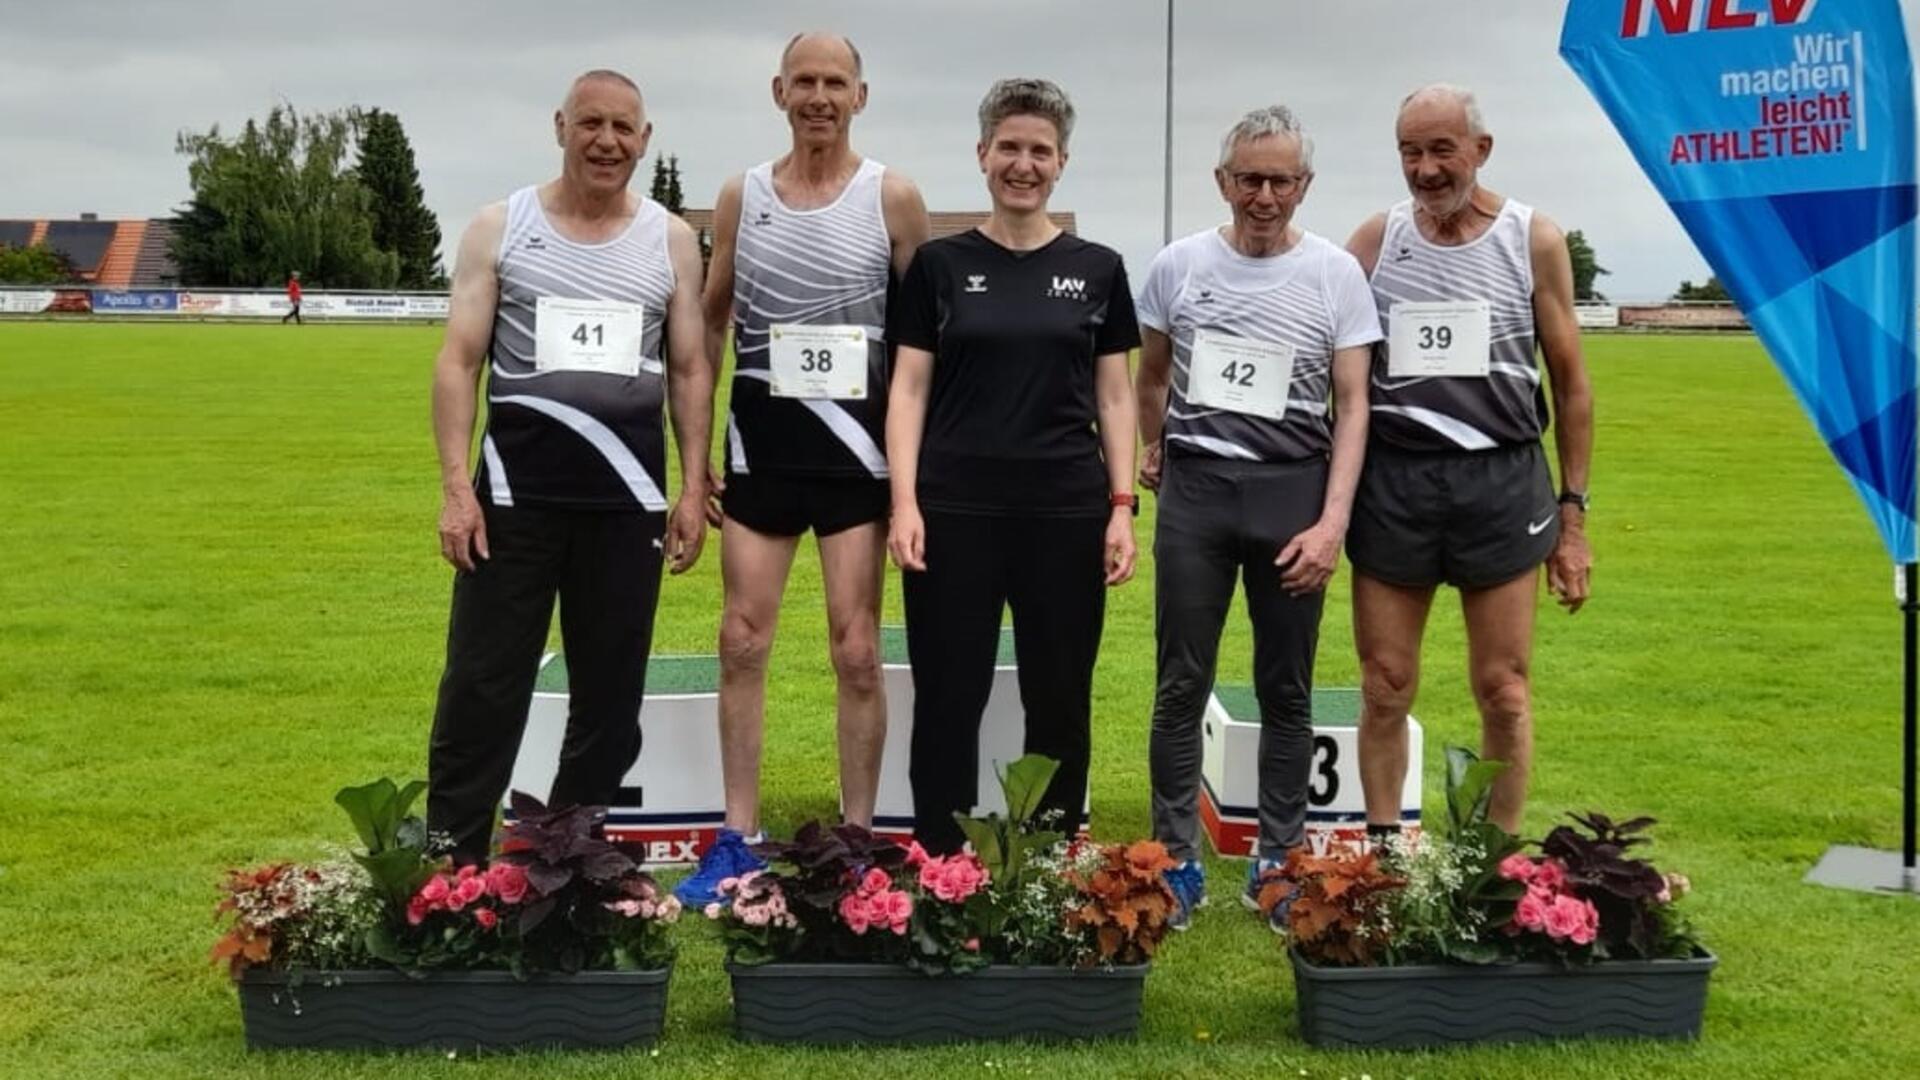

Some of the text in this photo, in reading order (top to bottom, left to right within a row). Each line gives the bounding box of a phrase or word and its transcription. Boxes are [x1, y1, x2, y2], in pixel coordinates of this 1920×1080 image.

[1793, 33, 1850, 64] Wir
[1720, 63, 1850, 97] machen
[1761, 91, 1852, 126] leicht
[1052, 275, 1086, 293] LAV
[571, 322, 604, 347] 41
[1418, 325, 1452, 350] 39
[800, 348, 833, 373] 38
[1220, 360, 1257, 387] 42
[1307, 735, 1339, 806] 3
